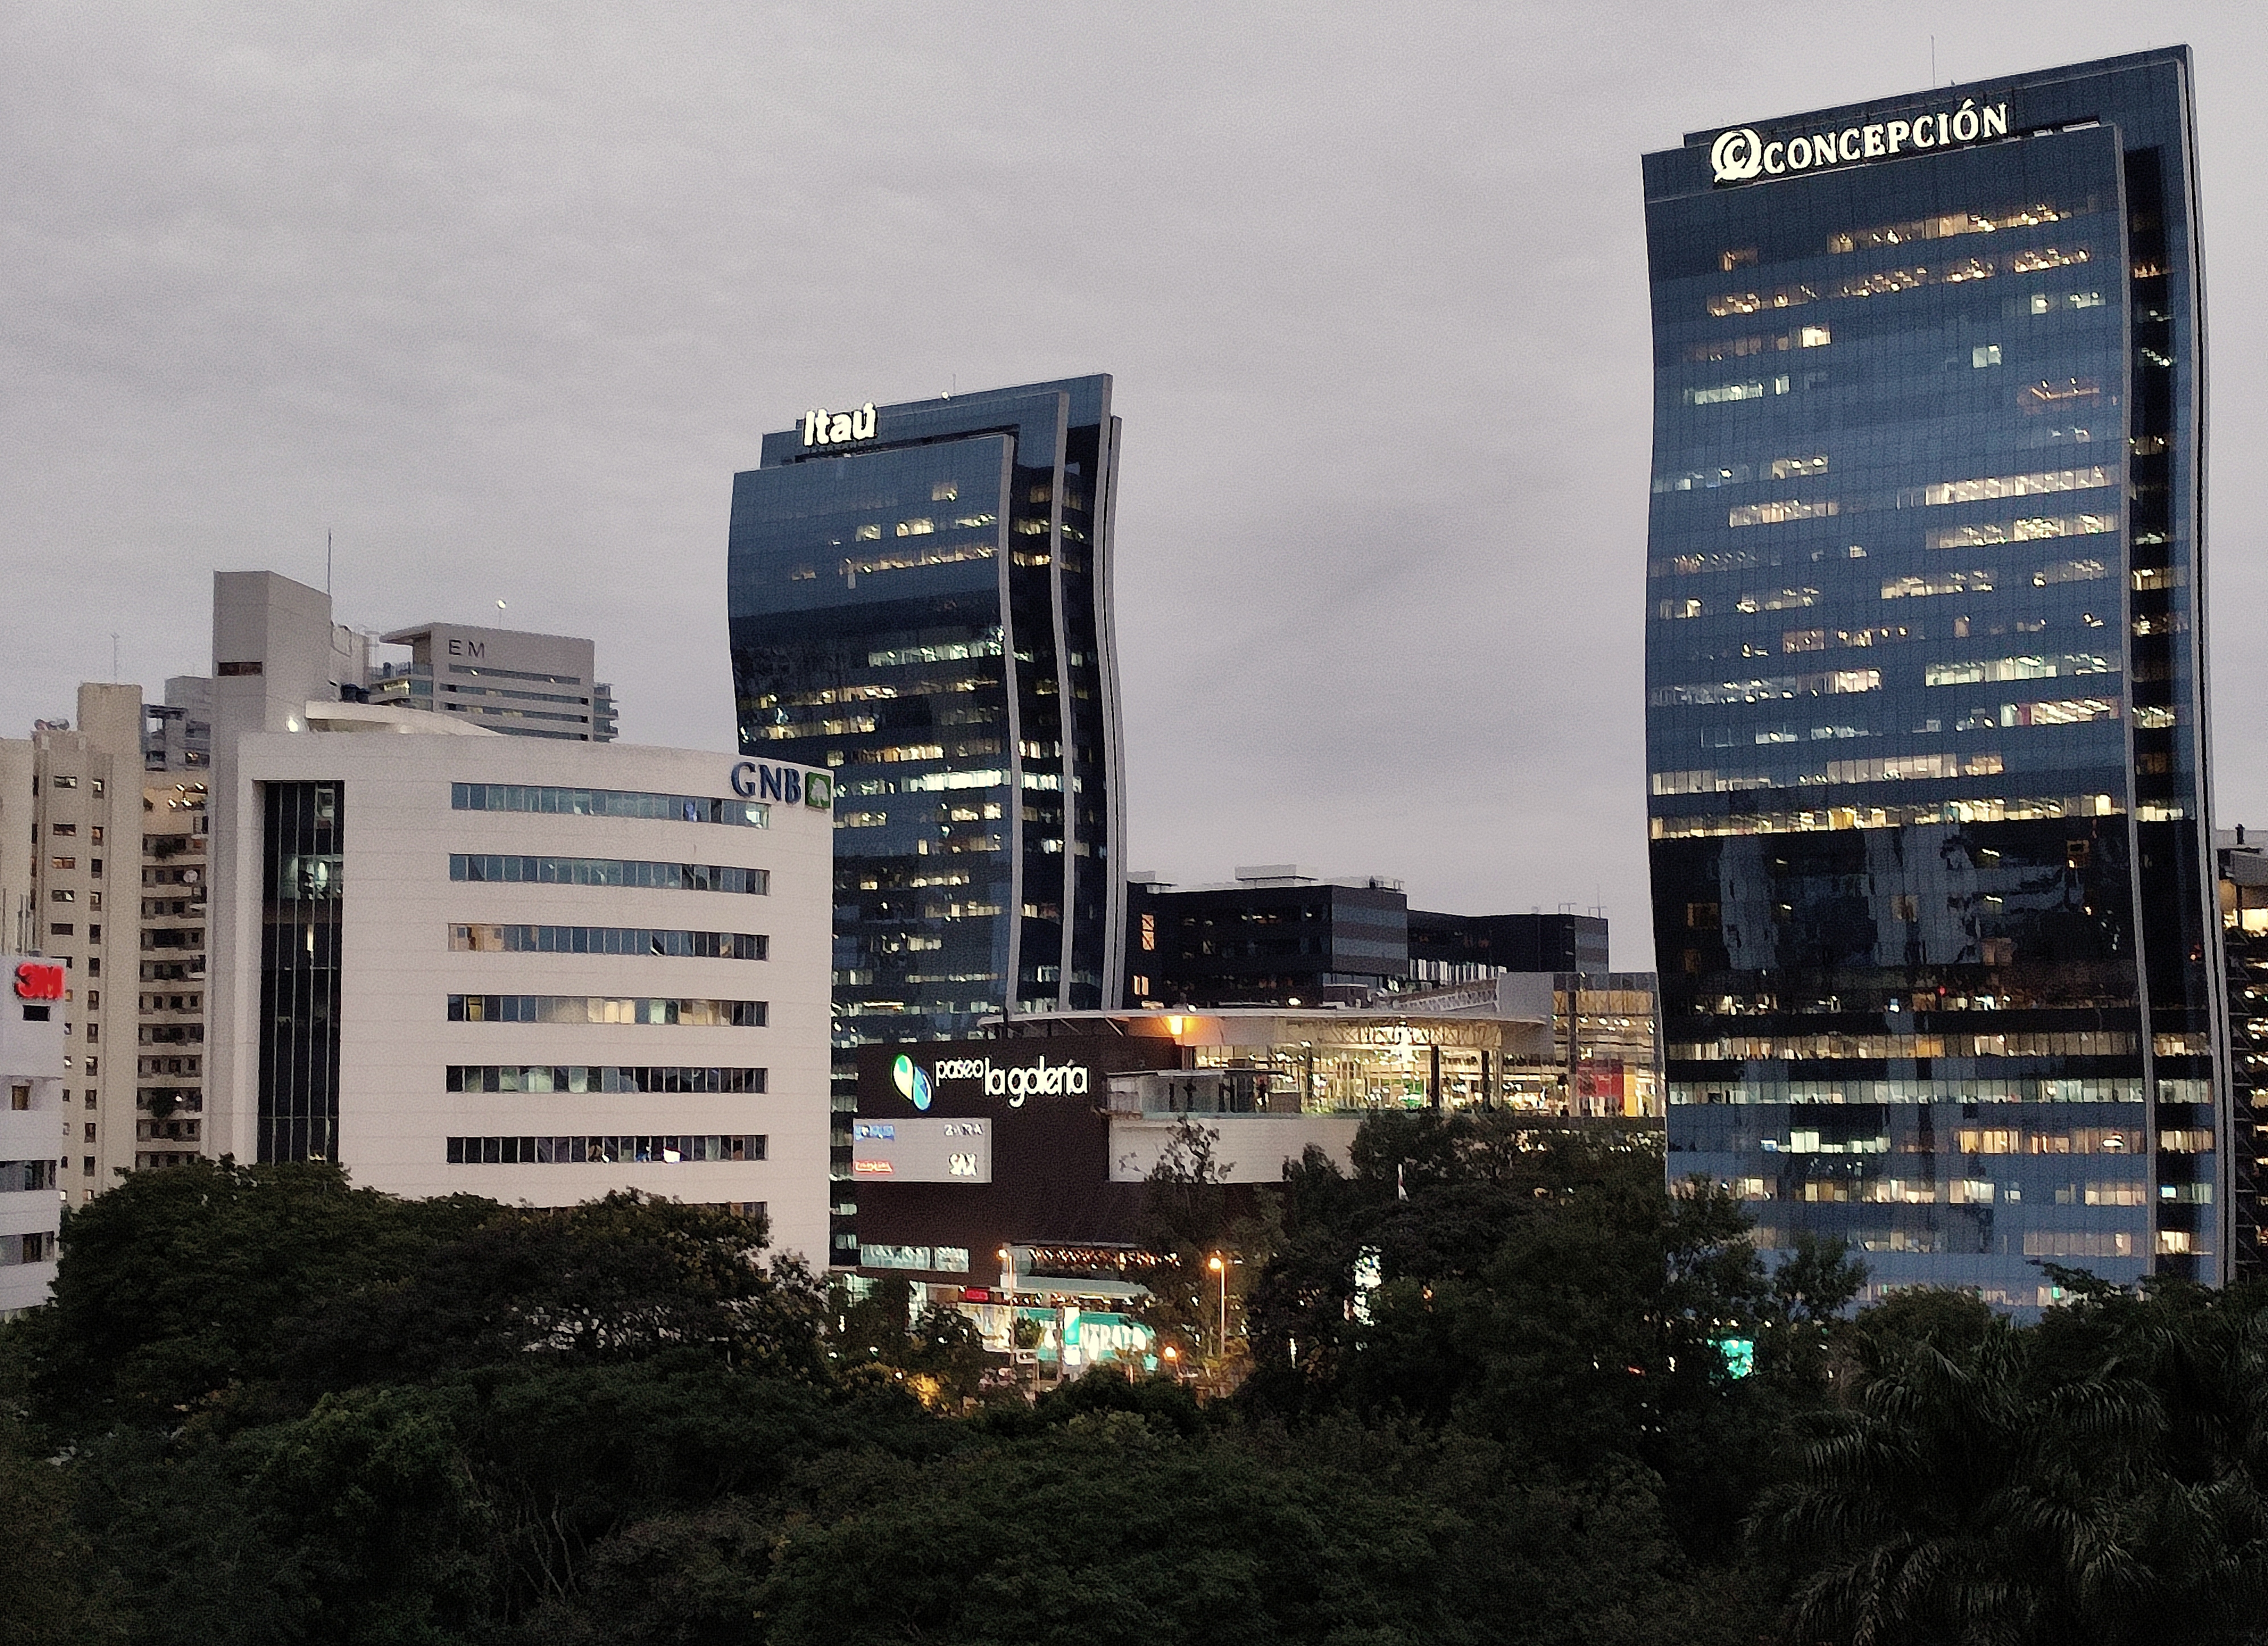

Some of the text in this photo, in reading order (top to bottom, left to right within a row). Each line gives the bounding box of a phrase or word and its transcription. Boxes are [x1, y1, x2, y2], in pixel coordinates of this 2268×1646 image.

[1763, 98, 2008, 175] CONCEPCIÓN
[731, 761, 801, 805] GNB
[18, 963, 65, 1000] 3M
[935, 1058, 984, 1087] paseo
